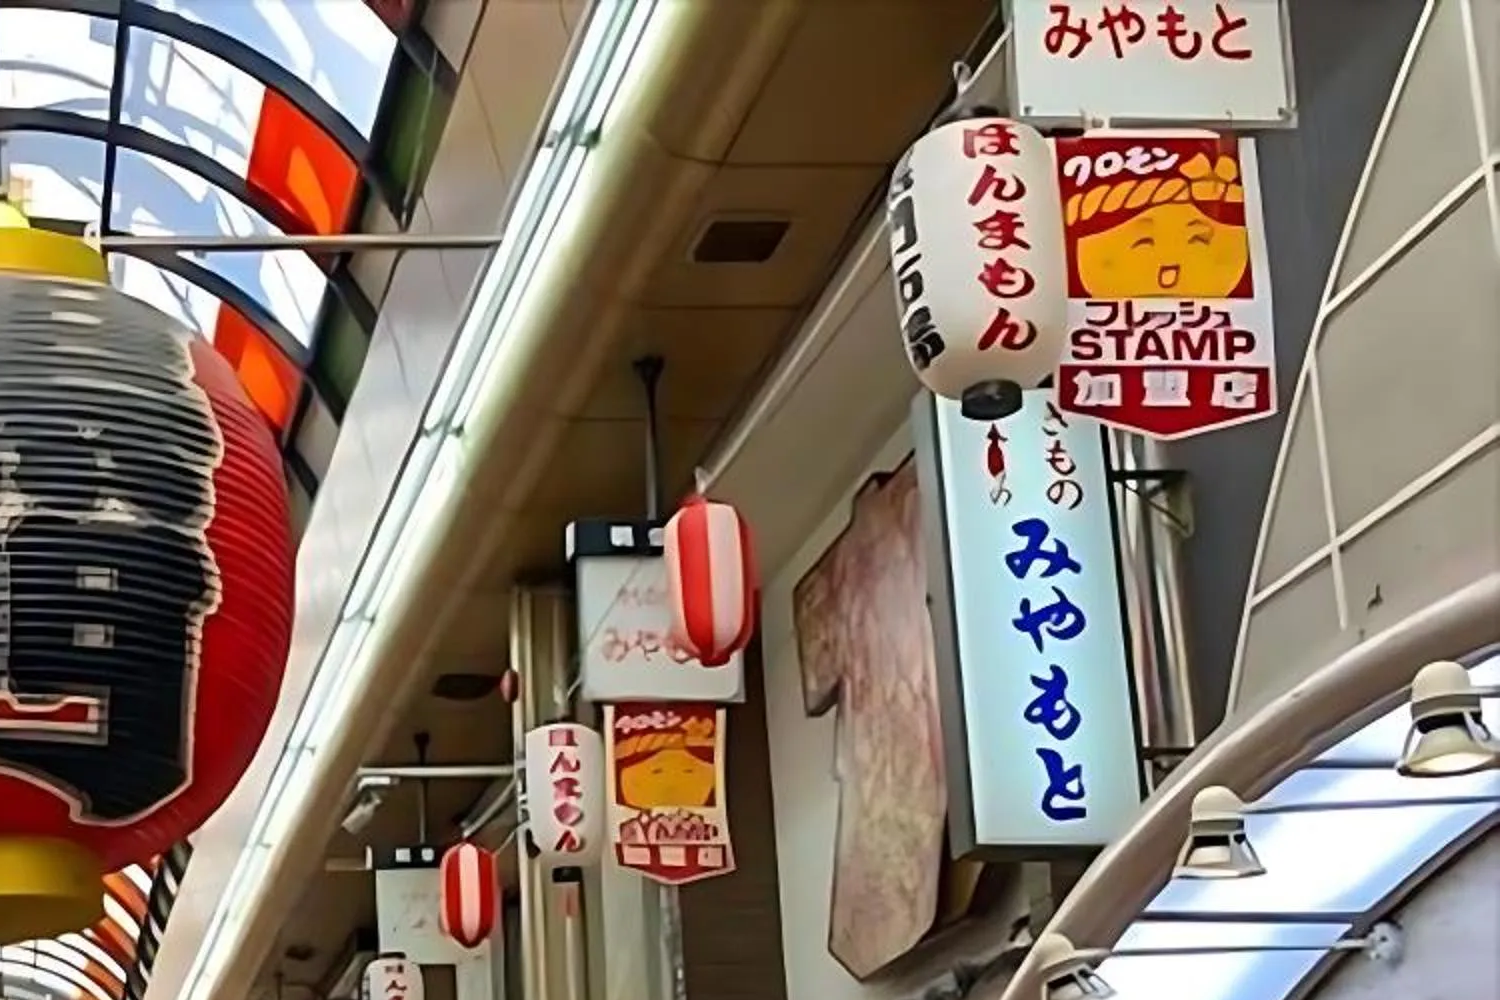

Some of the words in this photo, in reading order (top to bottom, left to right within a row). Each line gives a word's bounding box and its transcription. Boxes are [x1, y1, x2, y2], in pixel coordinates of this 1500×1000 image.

[1045, 4, 1252, 59] みやもと
[1063, 146, 1180, 187] クロモン
[962, 122, 1038, 351] ほんまもん
[1070, 329, 1256, 361] STAMP
[1004, 517, 1088, 820] みやもと
